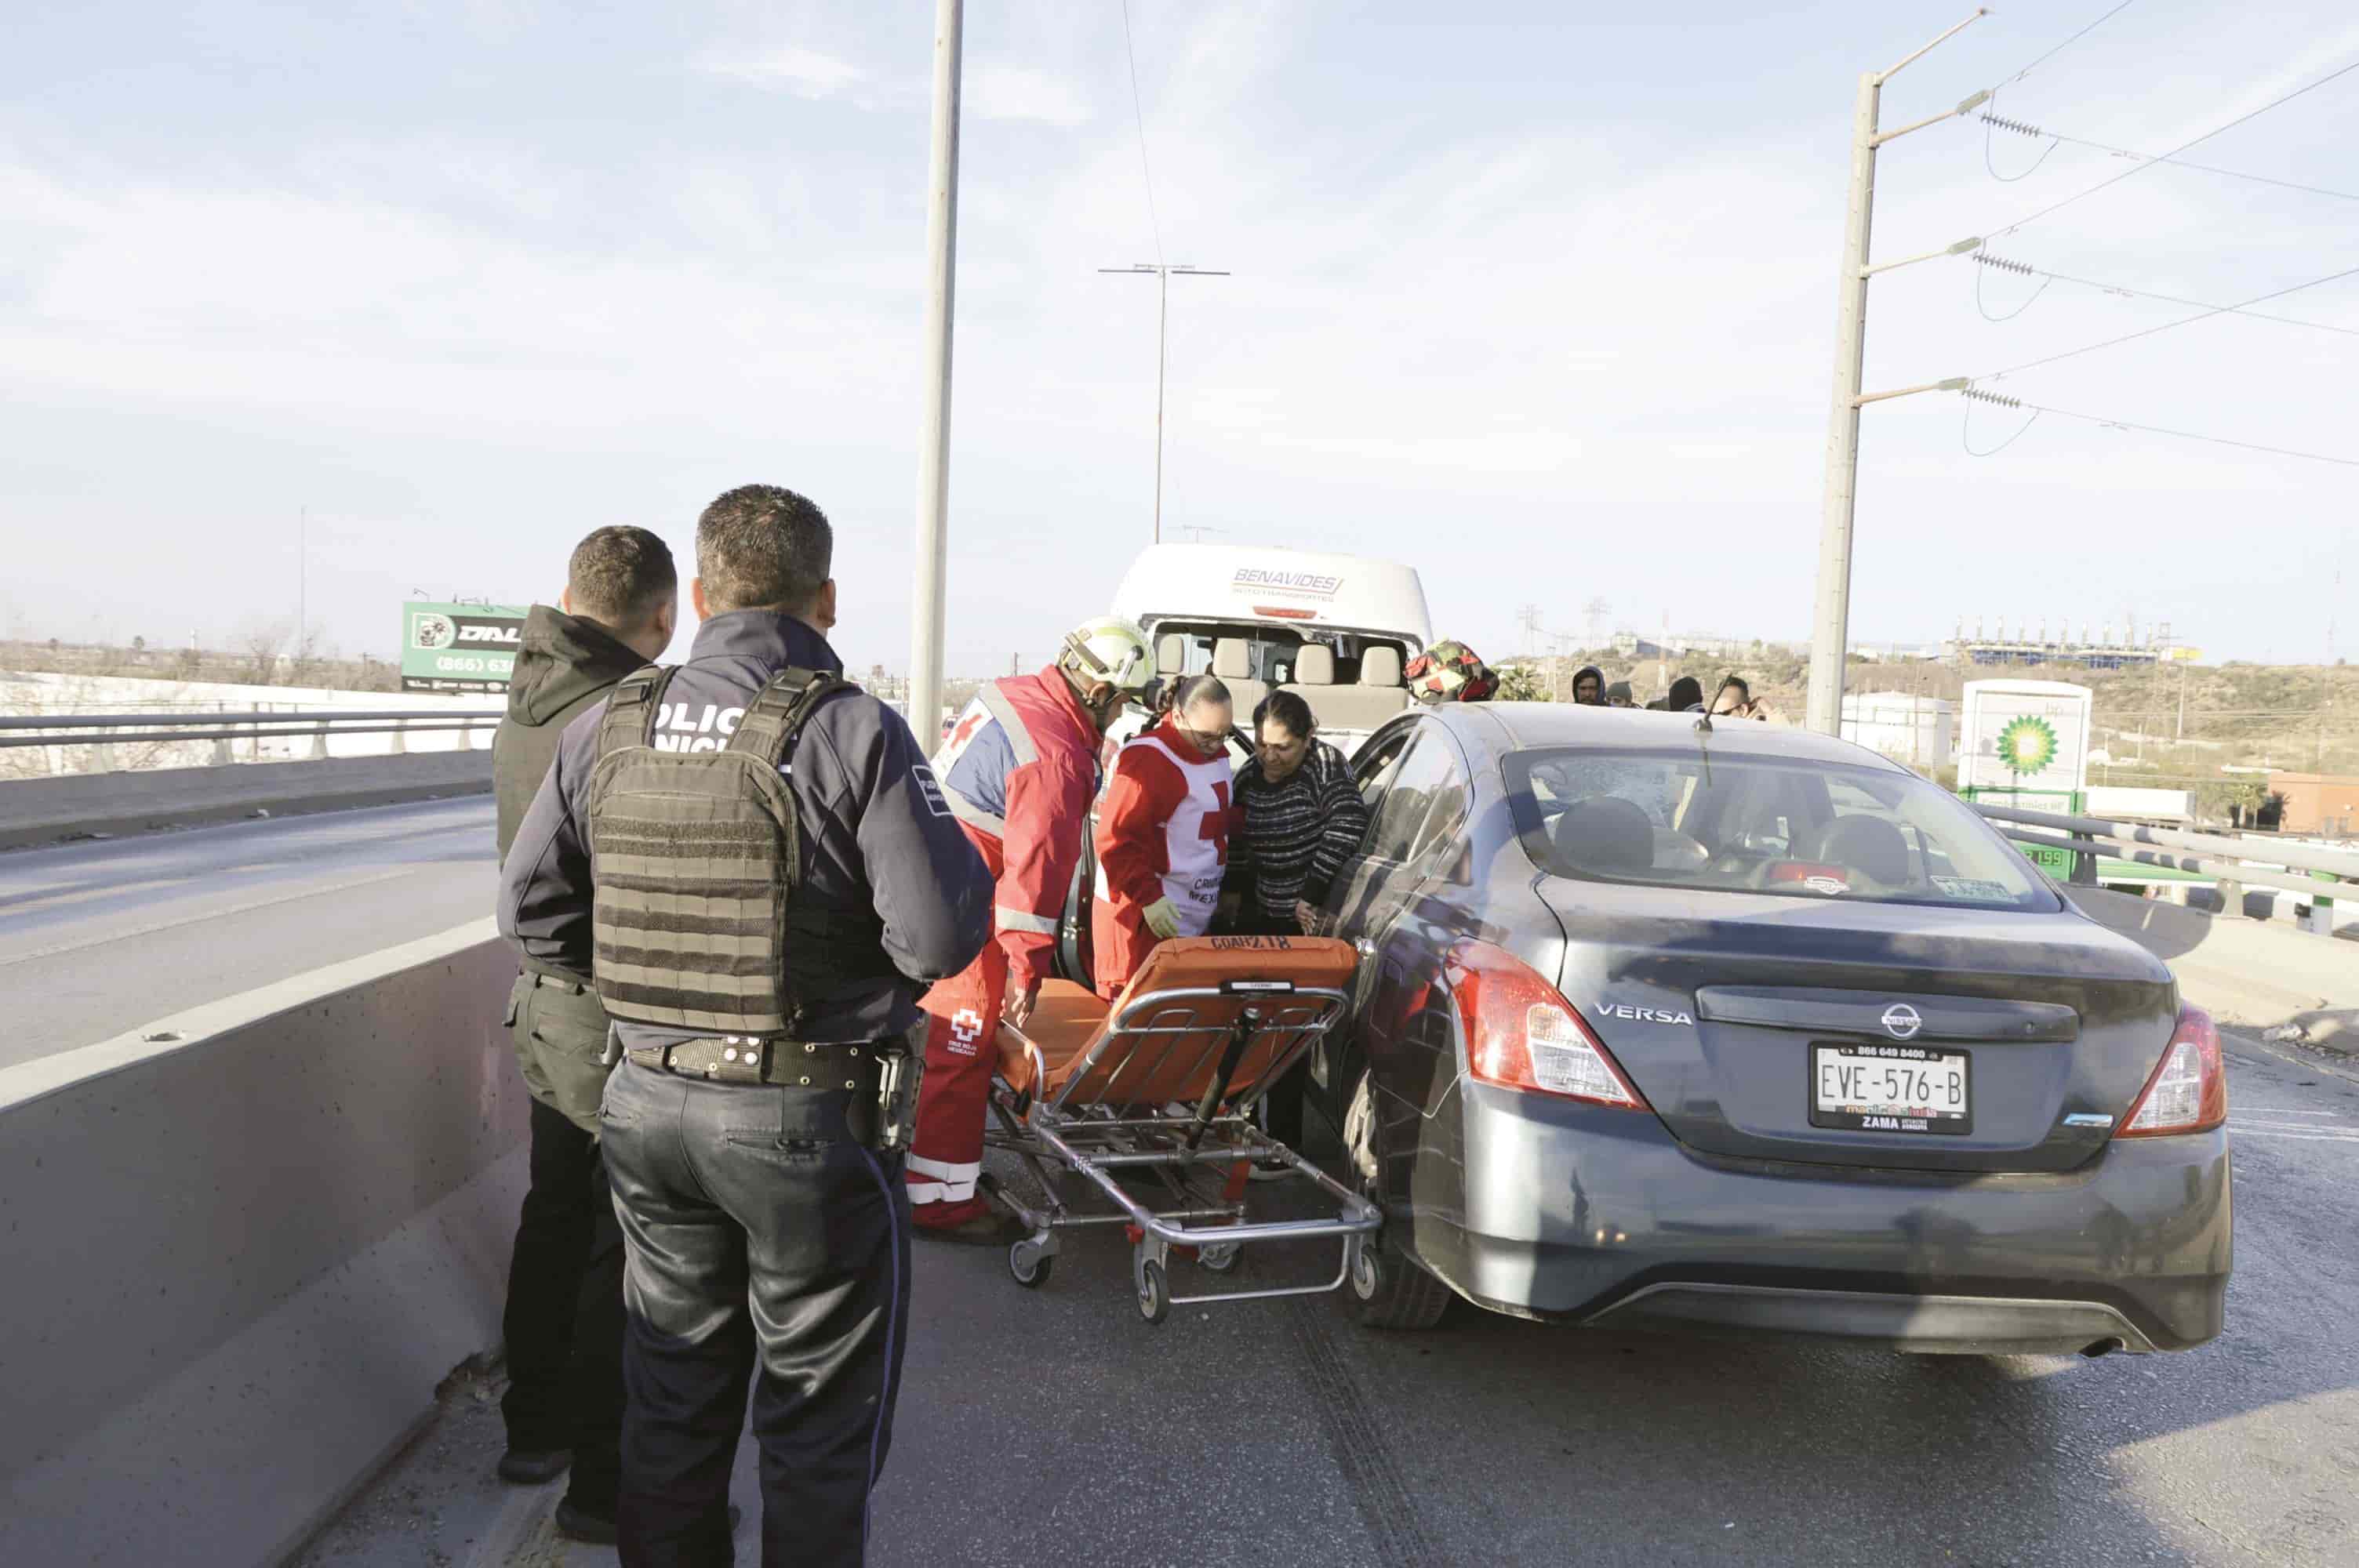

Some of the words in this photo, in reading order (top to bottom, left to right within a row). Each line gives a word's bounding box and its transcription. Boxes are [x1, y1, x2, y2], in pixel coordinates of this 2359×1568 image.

[1234, 568, 1336, 590] BENAVIDES
[1594, 1003, 1693, 1026] VERSA
[1879, 1047, 1898, 1058] 649
[1900, 1048, 1926, 1059] 8400
[1822, 1065, 1962, 1105] EVE-576-B
[1863, 1116, 1899, 1129] ZAMA
